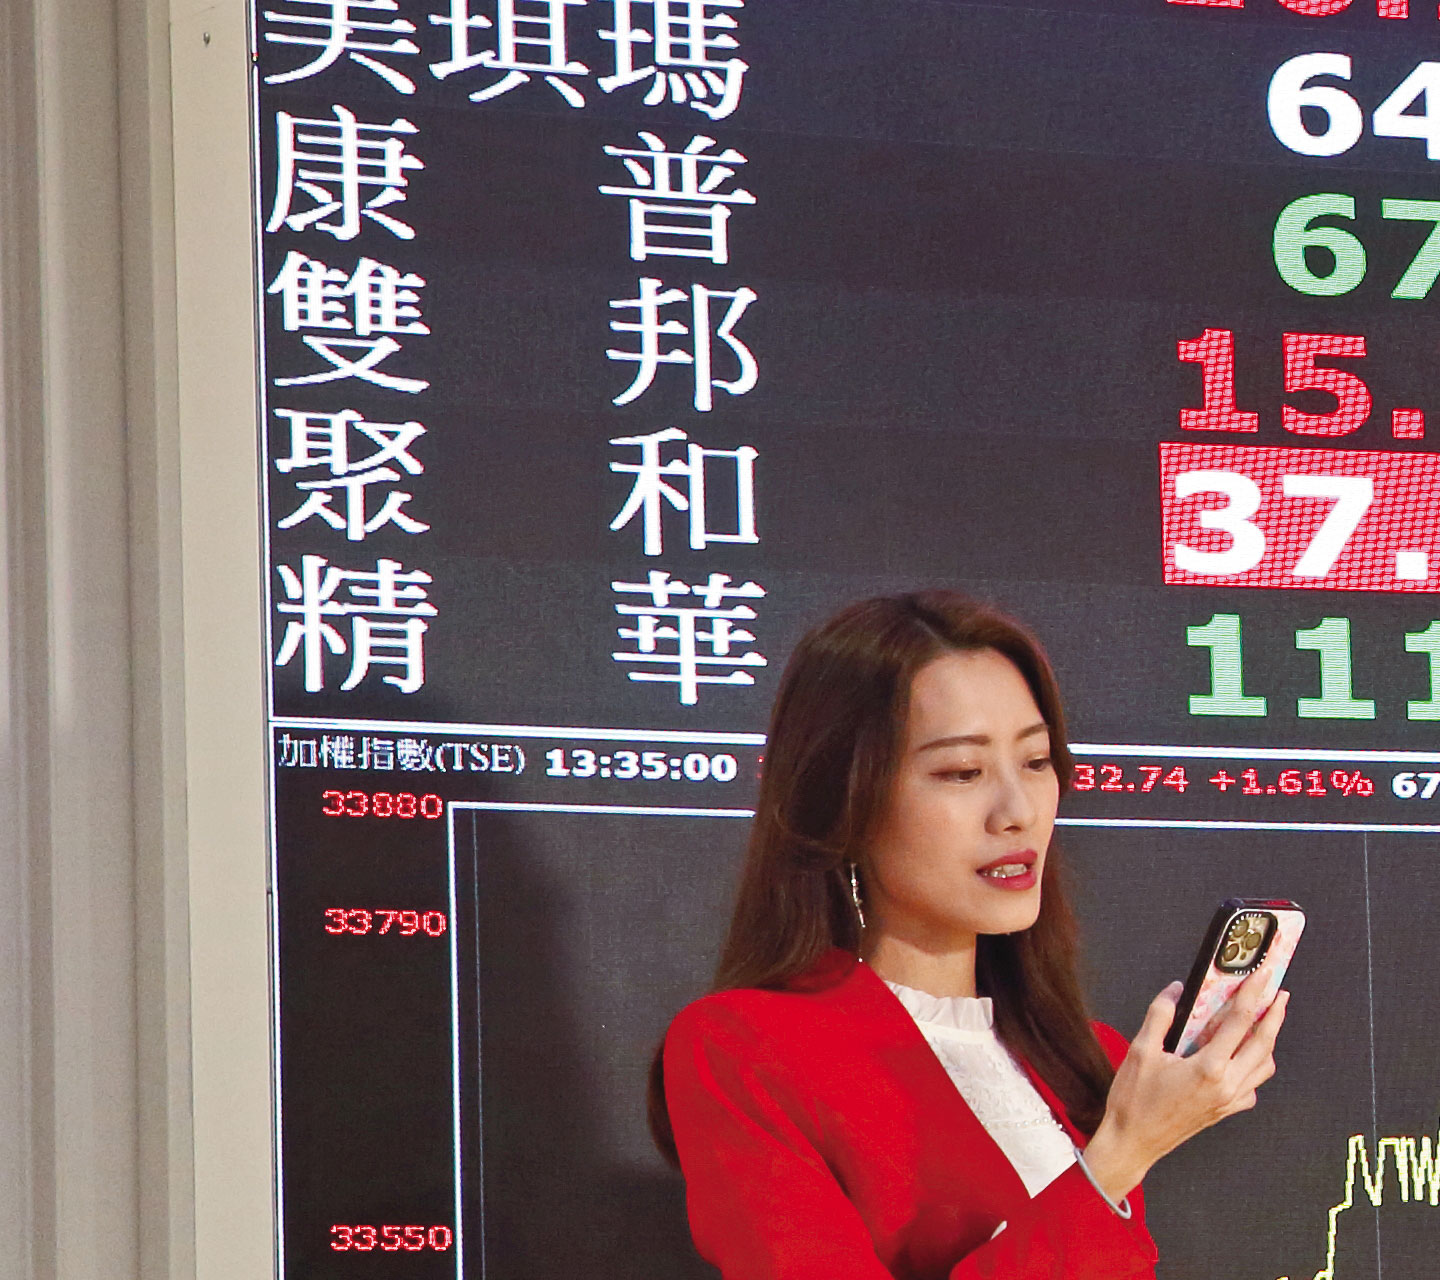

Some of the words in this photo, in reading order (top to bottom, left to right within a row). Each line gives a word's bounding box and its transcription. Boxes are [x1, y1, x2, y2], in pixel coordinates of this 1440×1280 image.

[266, 105, 426, 240] 康
[599, 132, 756, 264] 普
[267, 251, 430, 394] 雙
[606, 277, 758, 411] 邦
[273, 408, 430, 540] 聚
[609, 427, 760, 555] 和
[273, 554, 439, 695] 精
[612, 570, 768, 705] 華
[322, 790, 443, 819] 33880
[546, 749, 737, 781] 13:35:00
[1209, 768, 1375, 797] +1.61%
[324, 908, 446, 937] 33790
[330, 1225, 452, 1251] 33550
